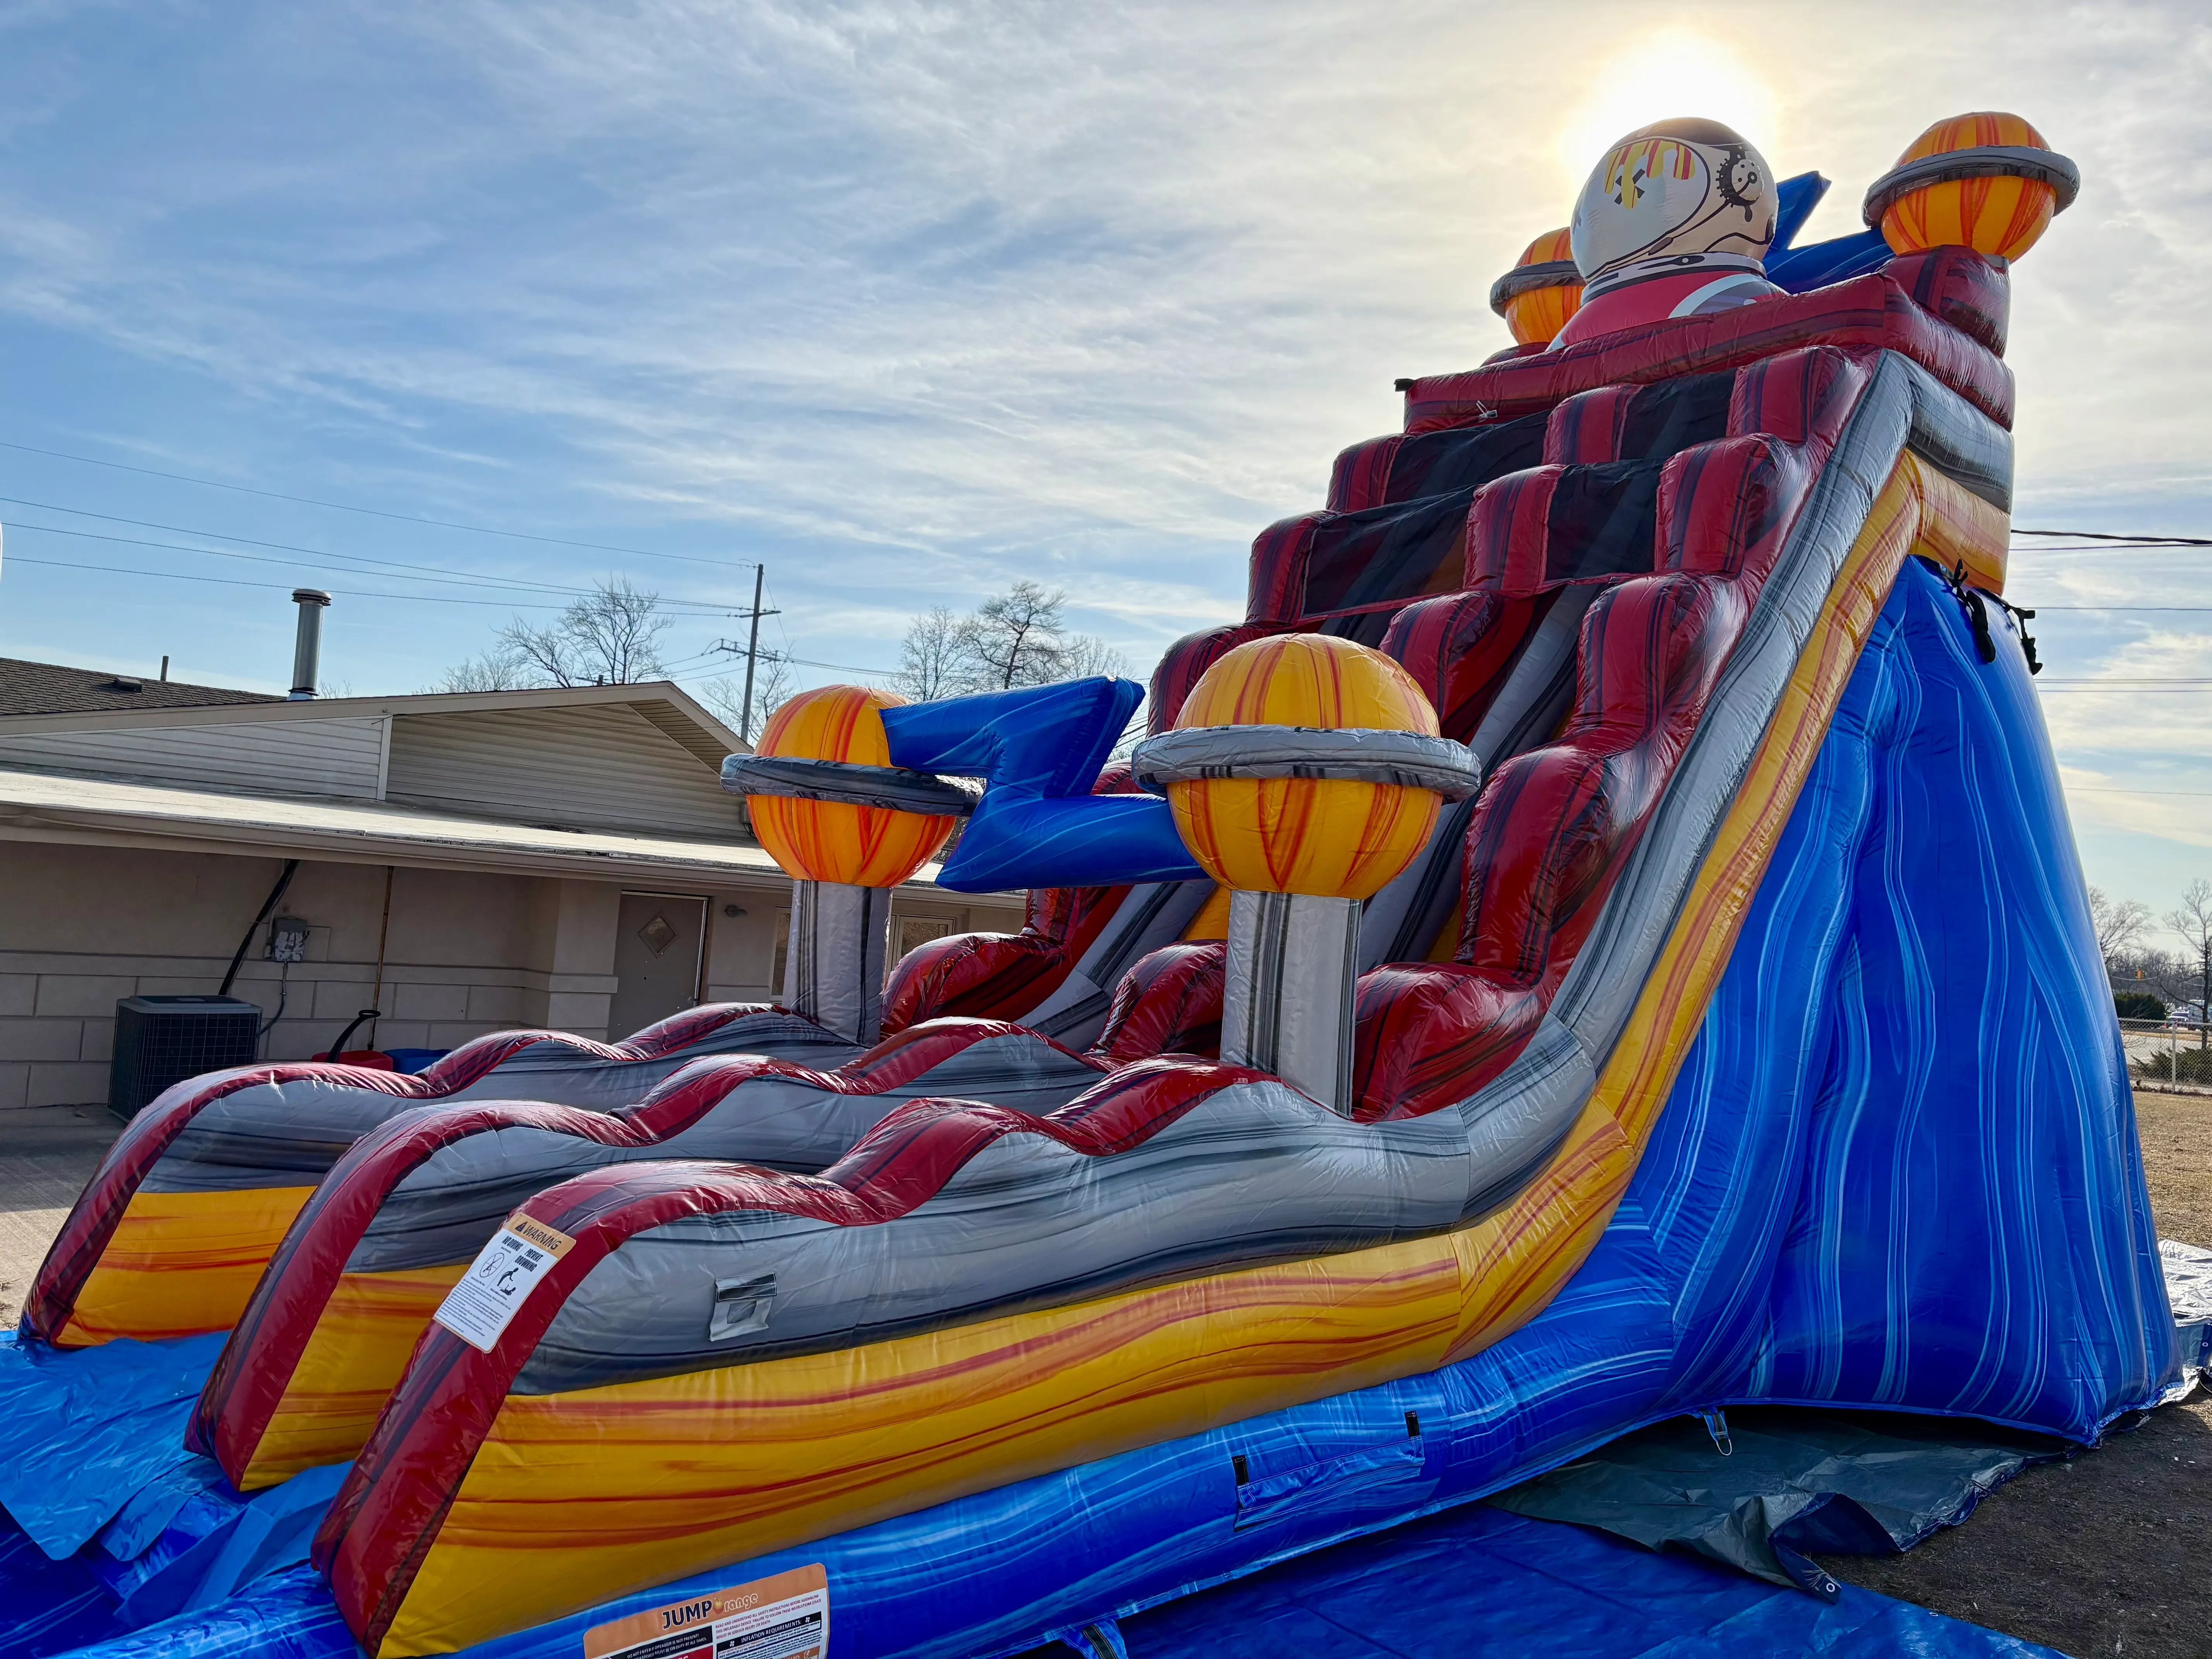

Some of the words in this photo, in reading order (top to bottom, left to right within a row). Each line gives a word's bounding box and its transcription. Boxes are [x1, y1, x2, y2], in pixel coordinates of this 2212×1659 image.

[502, 1236, 512, 1245] NO
[507, 1239, 523, 1251] DIVING
[523, 1225, 562, 1250] WARNING
[514, 1255, 537, 1272] DROWNING
[524, 1249, 543, 1262] PREVENT
[662, 1600, 712, 1630] JUMP
[741, 1631, 765, 1643] INFLATION
[766, 1620, 802, 1635] REQUIREMENTS:
